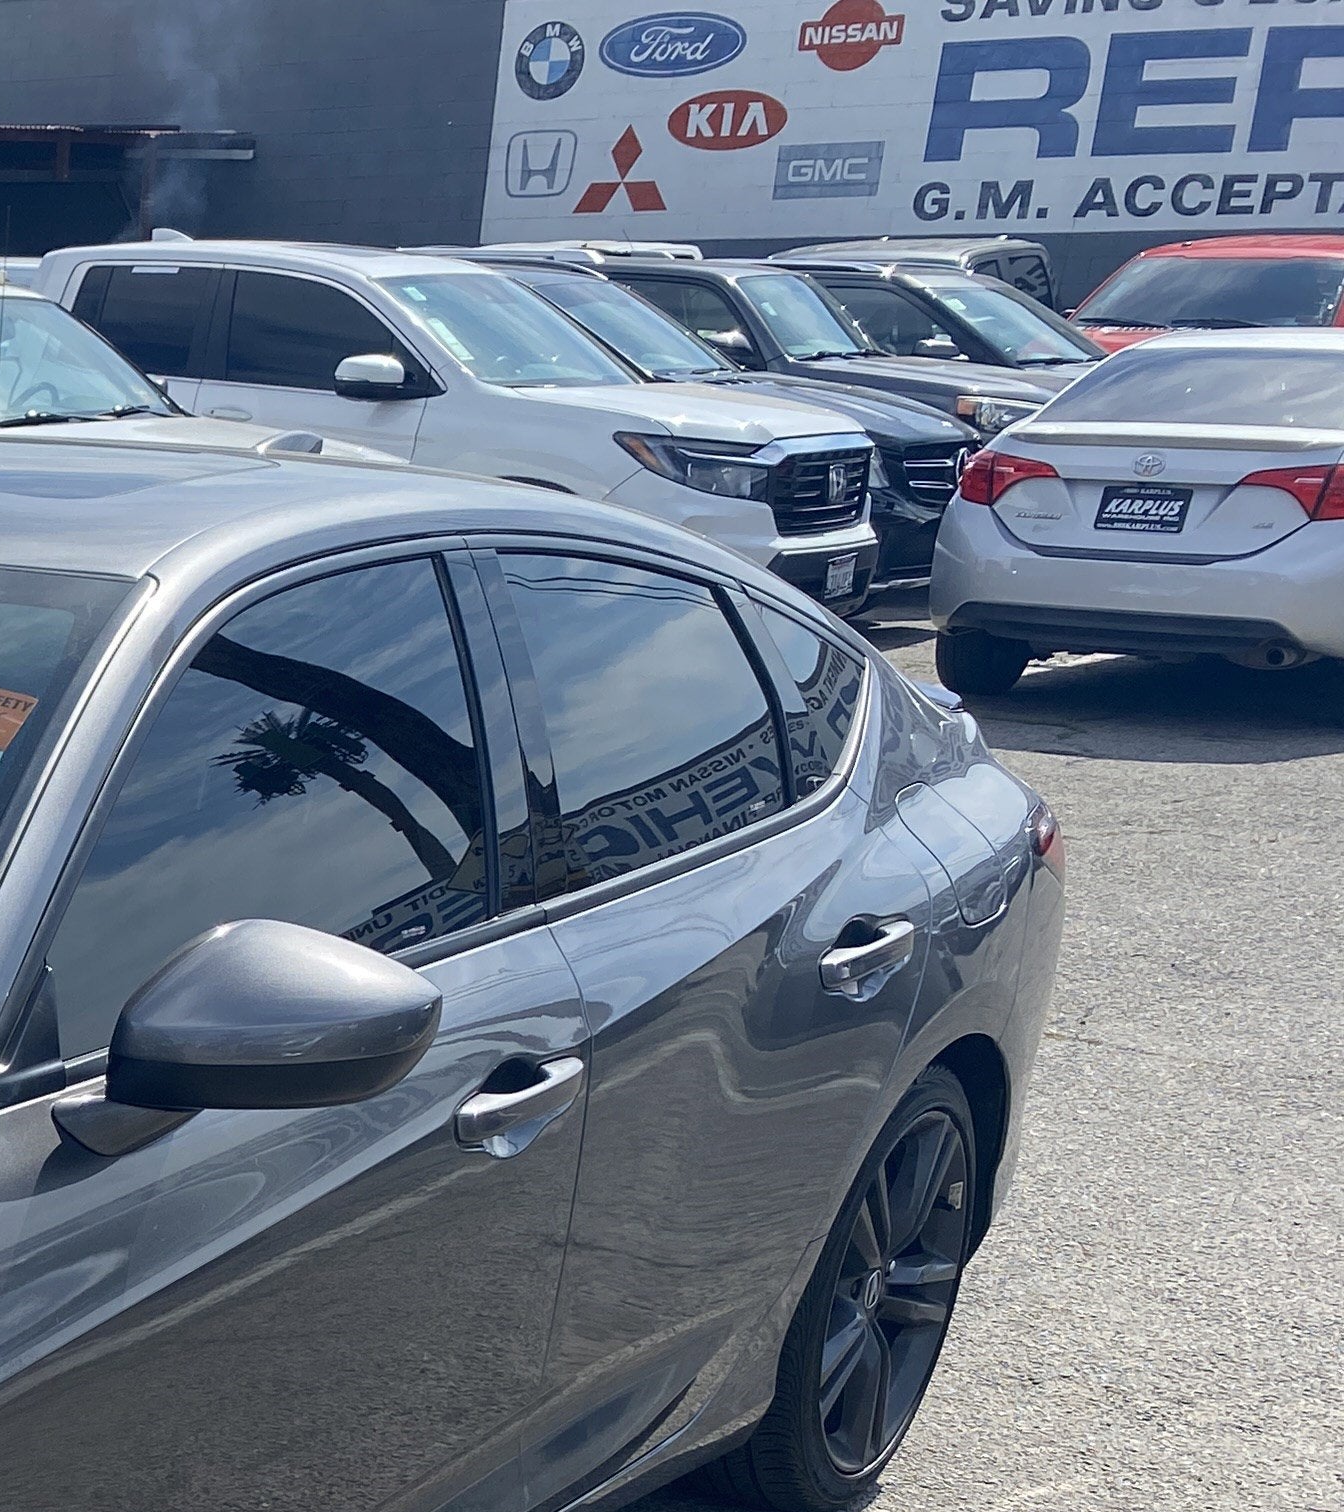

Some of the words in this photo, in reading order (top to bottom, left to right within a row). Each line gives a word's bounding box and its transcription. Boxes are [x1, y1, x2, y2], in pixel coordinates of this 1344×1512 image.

[630, 26, 714, 63] Ford
[804, 21, 898, 46] NISSAN
[686, 101, 769, 138] KIA
[787, 157, 870, 183] GMC
[912, 178, 1050, 222] G.M.
[1073, 172, 1344, 218] ACCEPT
[1105, 498, 1184, 515] KARPLUS
